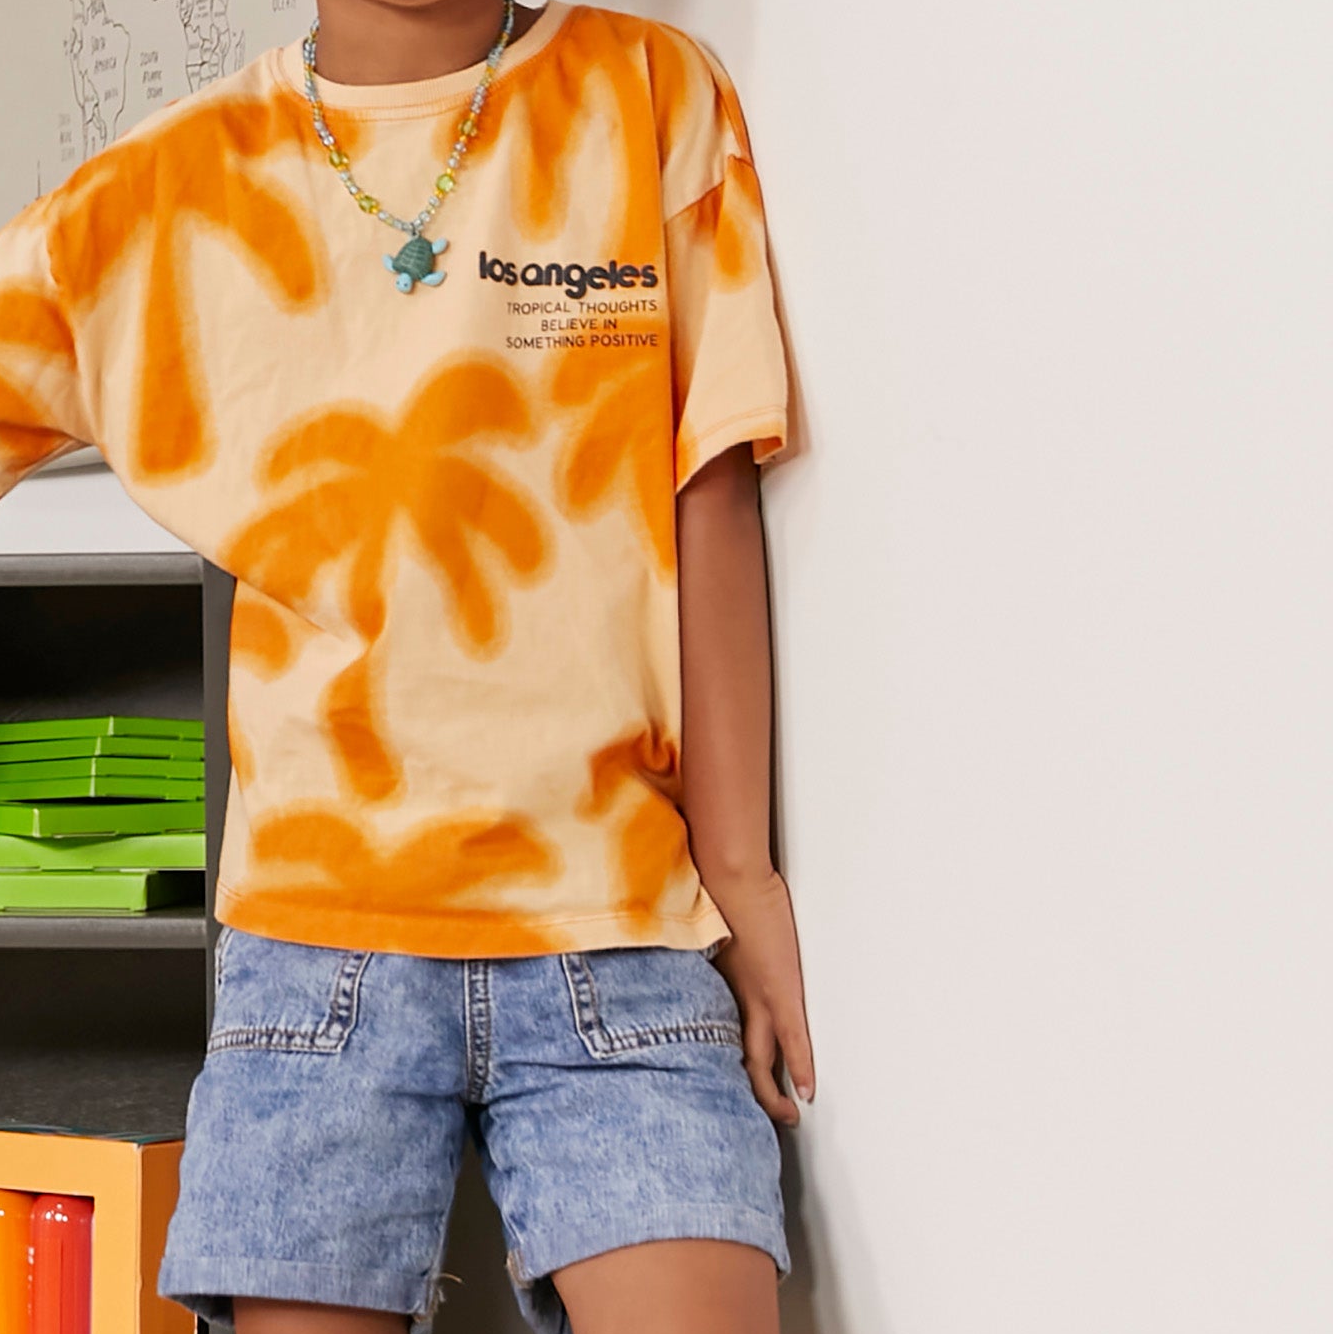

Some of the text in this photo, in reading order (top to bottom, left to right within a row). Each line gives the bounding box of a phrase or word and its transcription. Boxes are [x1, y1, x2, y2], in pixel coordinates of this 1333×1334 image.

[479, 251, 658, 299] los angeles
[507, 299, 657, 316] TROPICAL THOUGHTS
[541, 319, 617, 332] BELIEVE IN
[506, 334, 658, 349] SOMETHING POSITIVE
